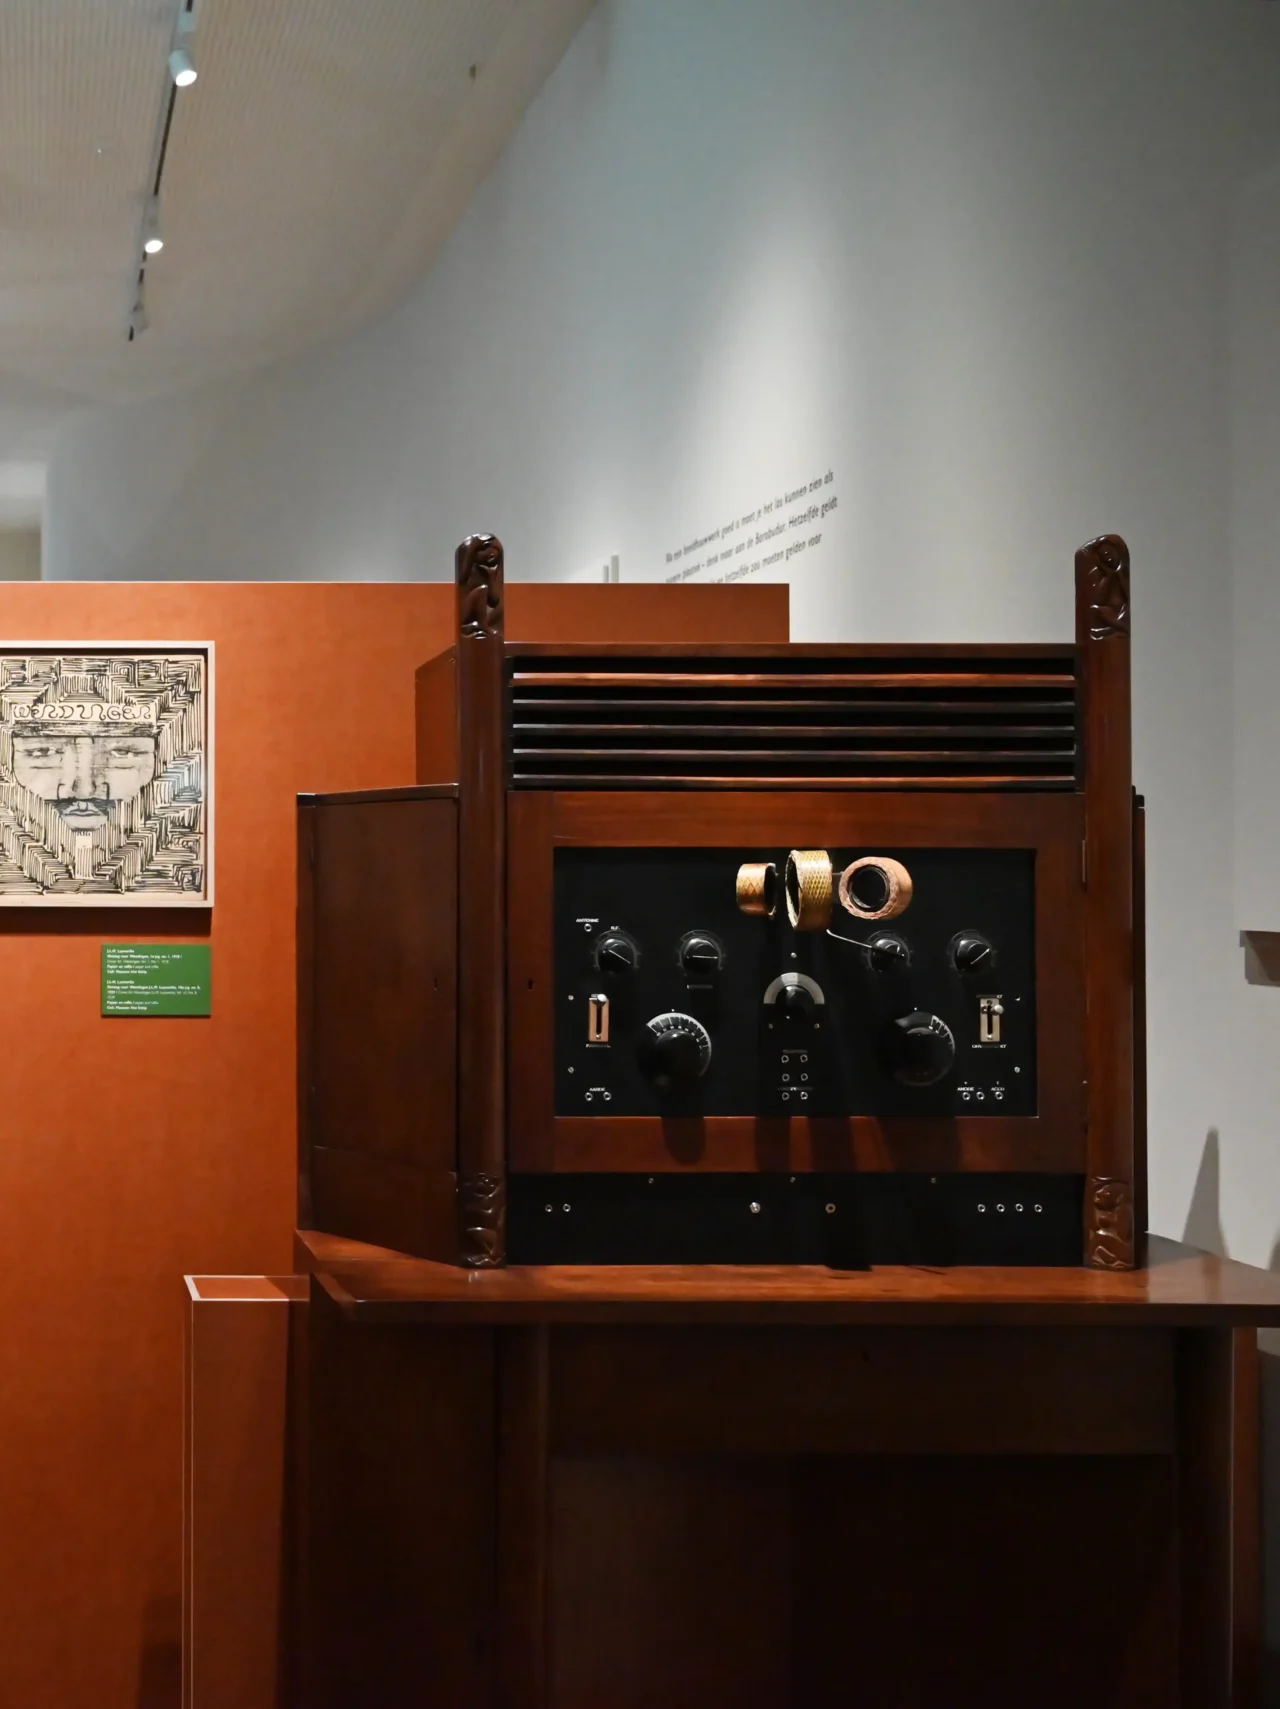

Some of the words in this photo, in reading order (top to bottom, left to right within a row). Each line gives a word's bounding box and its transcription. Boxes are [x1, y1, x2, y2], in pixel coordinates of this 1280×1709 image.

[741, 511, 755, 526] moet
[763, 501, 773, 515] het
[785, 485, 807, 504] kunnen
[809, 477, 822, 492] zien
[824, 468, 834, 485] als
[789, 504, 819, 528] Hetzelfde
[821, 495, 838, 519] geldt
[762, 550, 784, 568] moeten
[785, 539, 806, 561] gelden
[808, 533, 822, 548] voor
